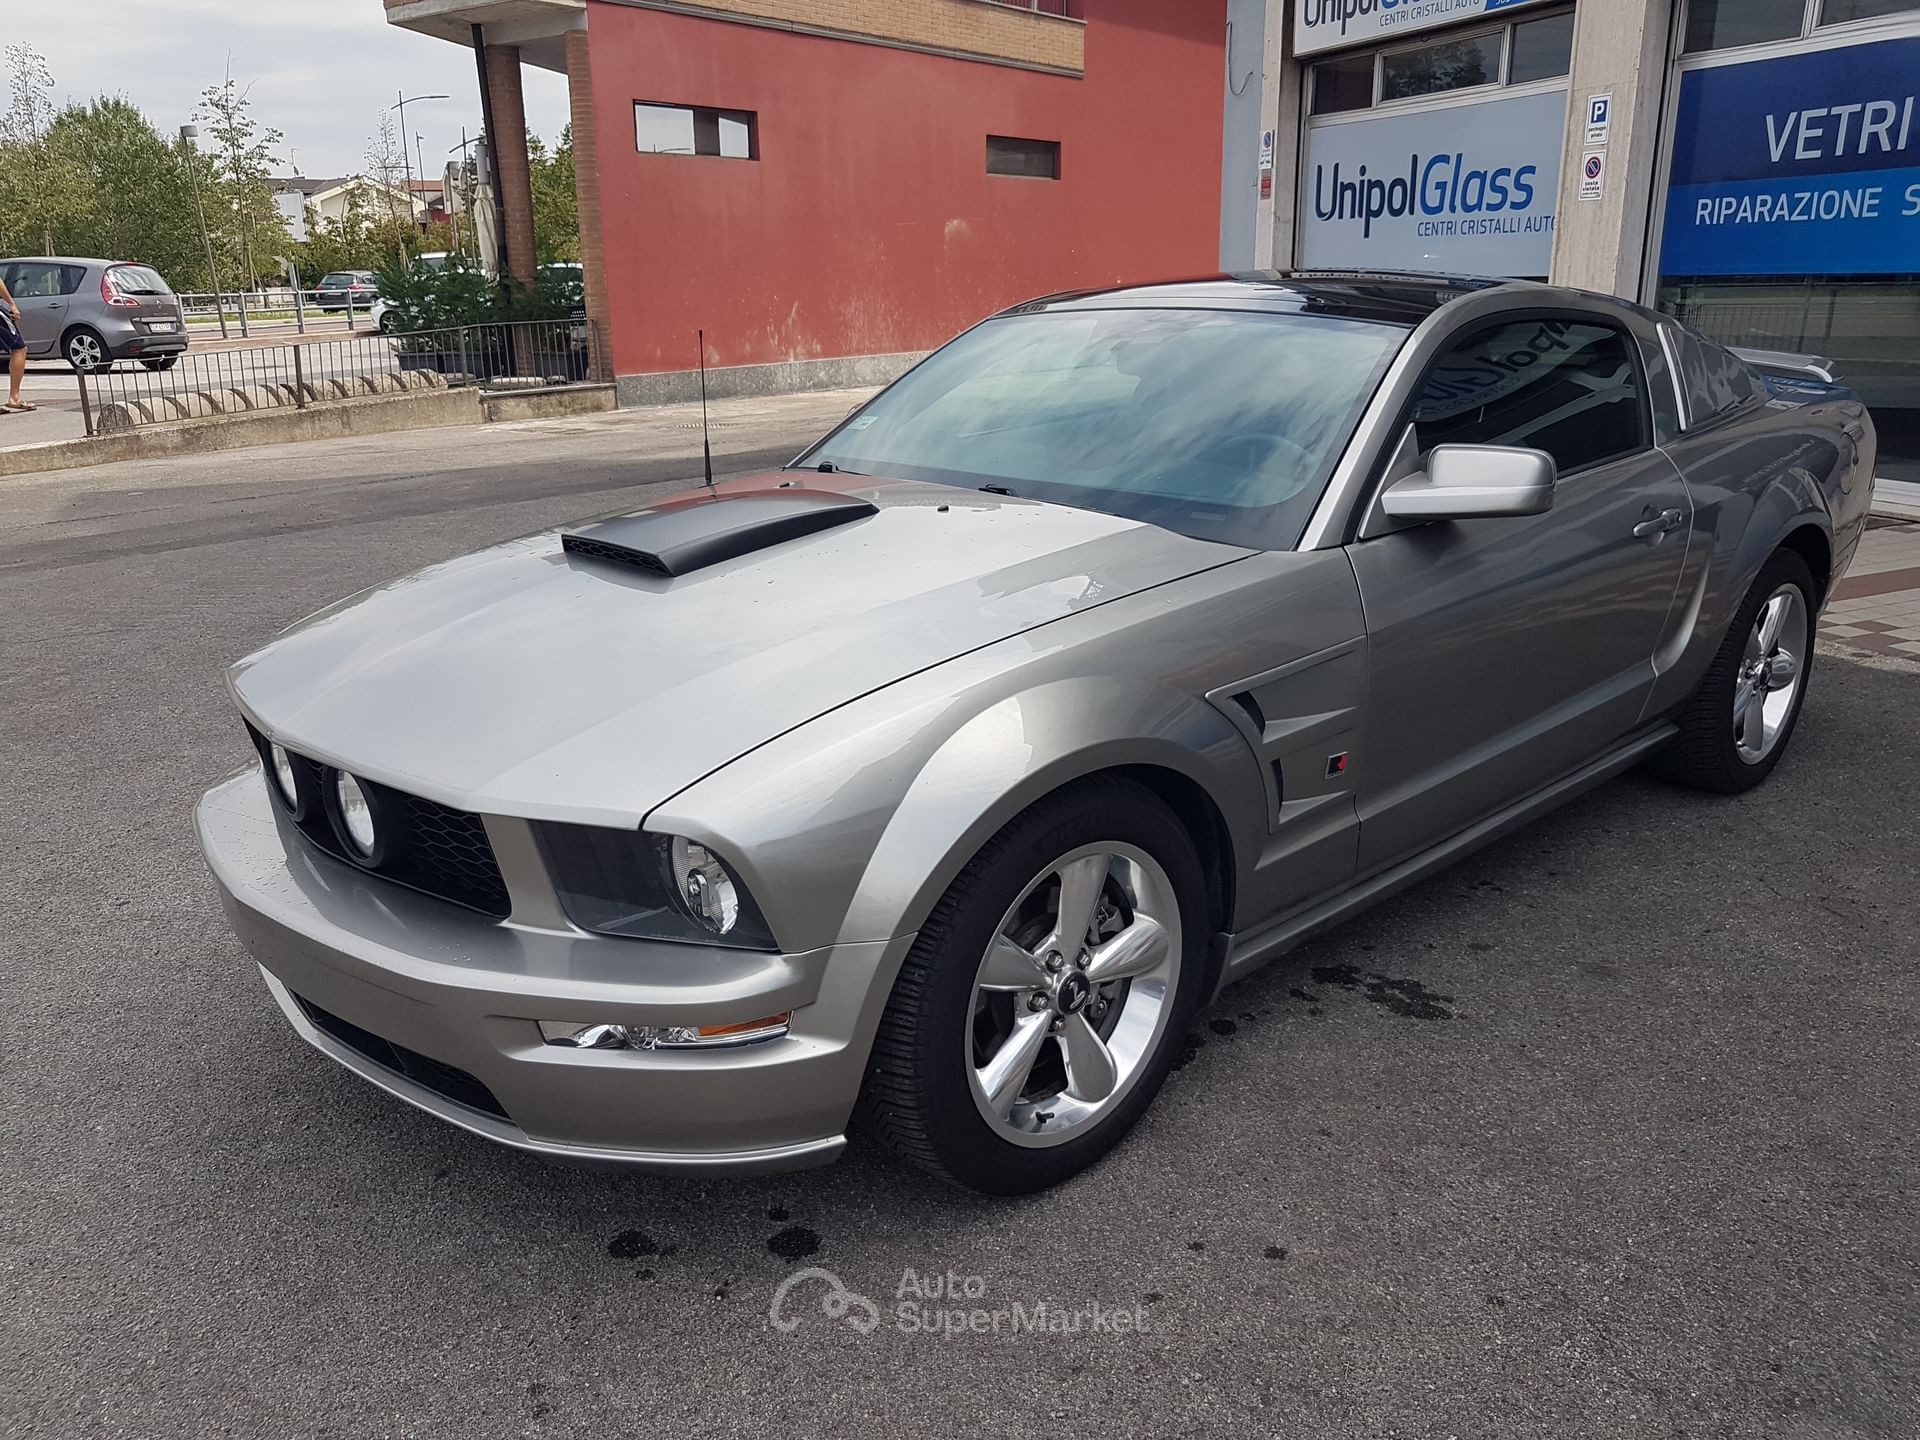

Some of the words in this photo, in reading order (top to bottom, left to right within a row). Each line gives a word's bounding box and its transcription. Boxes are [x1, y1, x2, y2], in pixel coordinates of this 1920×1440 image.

[1379, 10, 1408, 27] CENTRI
[1411, 0, 1452, 19] CRISTALLI
[1593, 102, 1605, 121] P
[1765, 96, 1915, 163] VETRI
[1315, 153, 1537, 239] UnipolGlass
[1695, 187, 1883, 226] RIPARAZIONE
[1417, 221, 1457, 237] CENTRI
[1460, 217, 1521, 236] CRISTALLI
